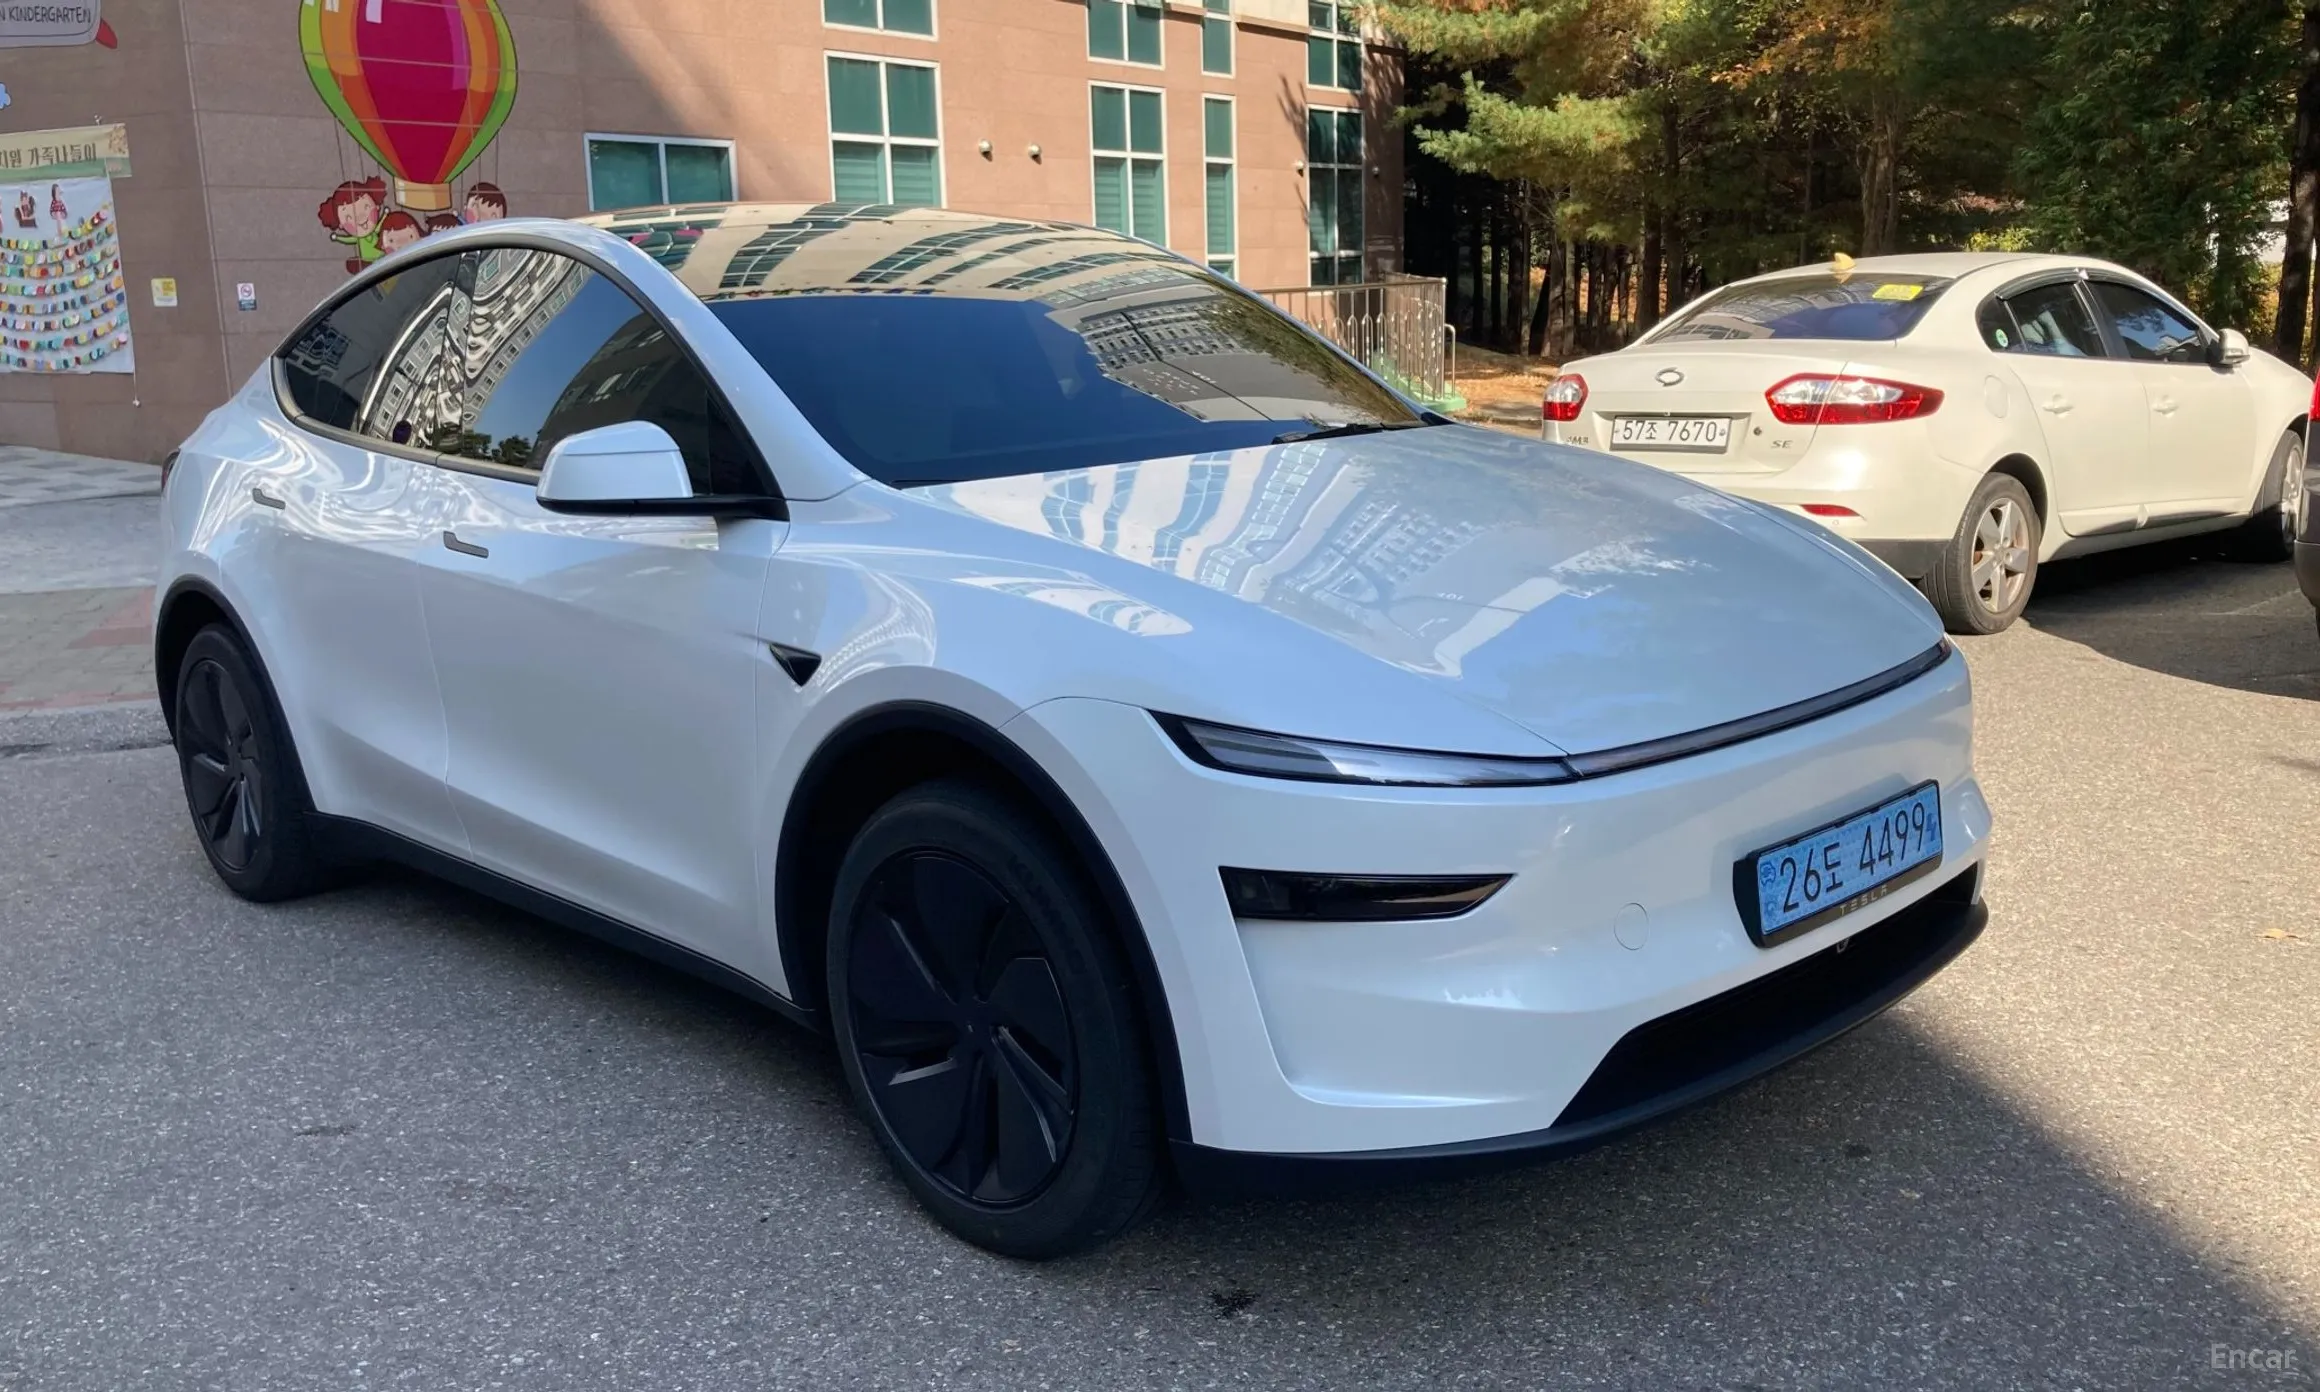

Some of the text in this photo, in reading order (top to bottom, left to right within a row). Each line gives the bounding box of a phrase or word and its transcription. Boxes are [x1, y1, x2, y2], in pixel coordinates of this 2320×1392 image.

[8, 6, 91, 23] KINDERGARTEN
[28, 142, 97, 167] 가족나들이
[1622, 419, 1718, 443] 57조 7670
[1771, 440, 1794, 449] SE
[1780, 802, 1925, 913] 26도 4499
[1839, 885, 1888, 916] TESLA
